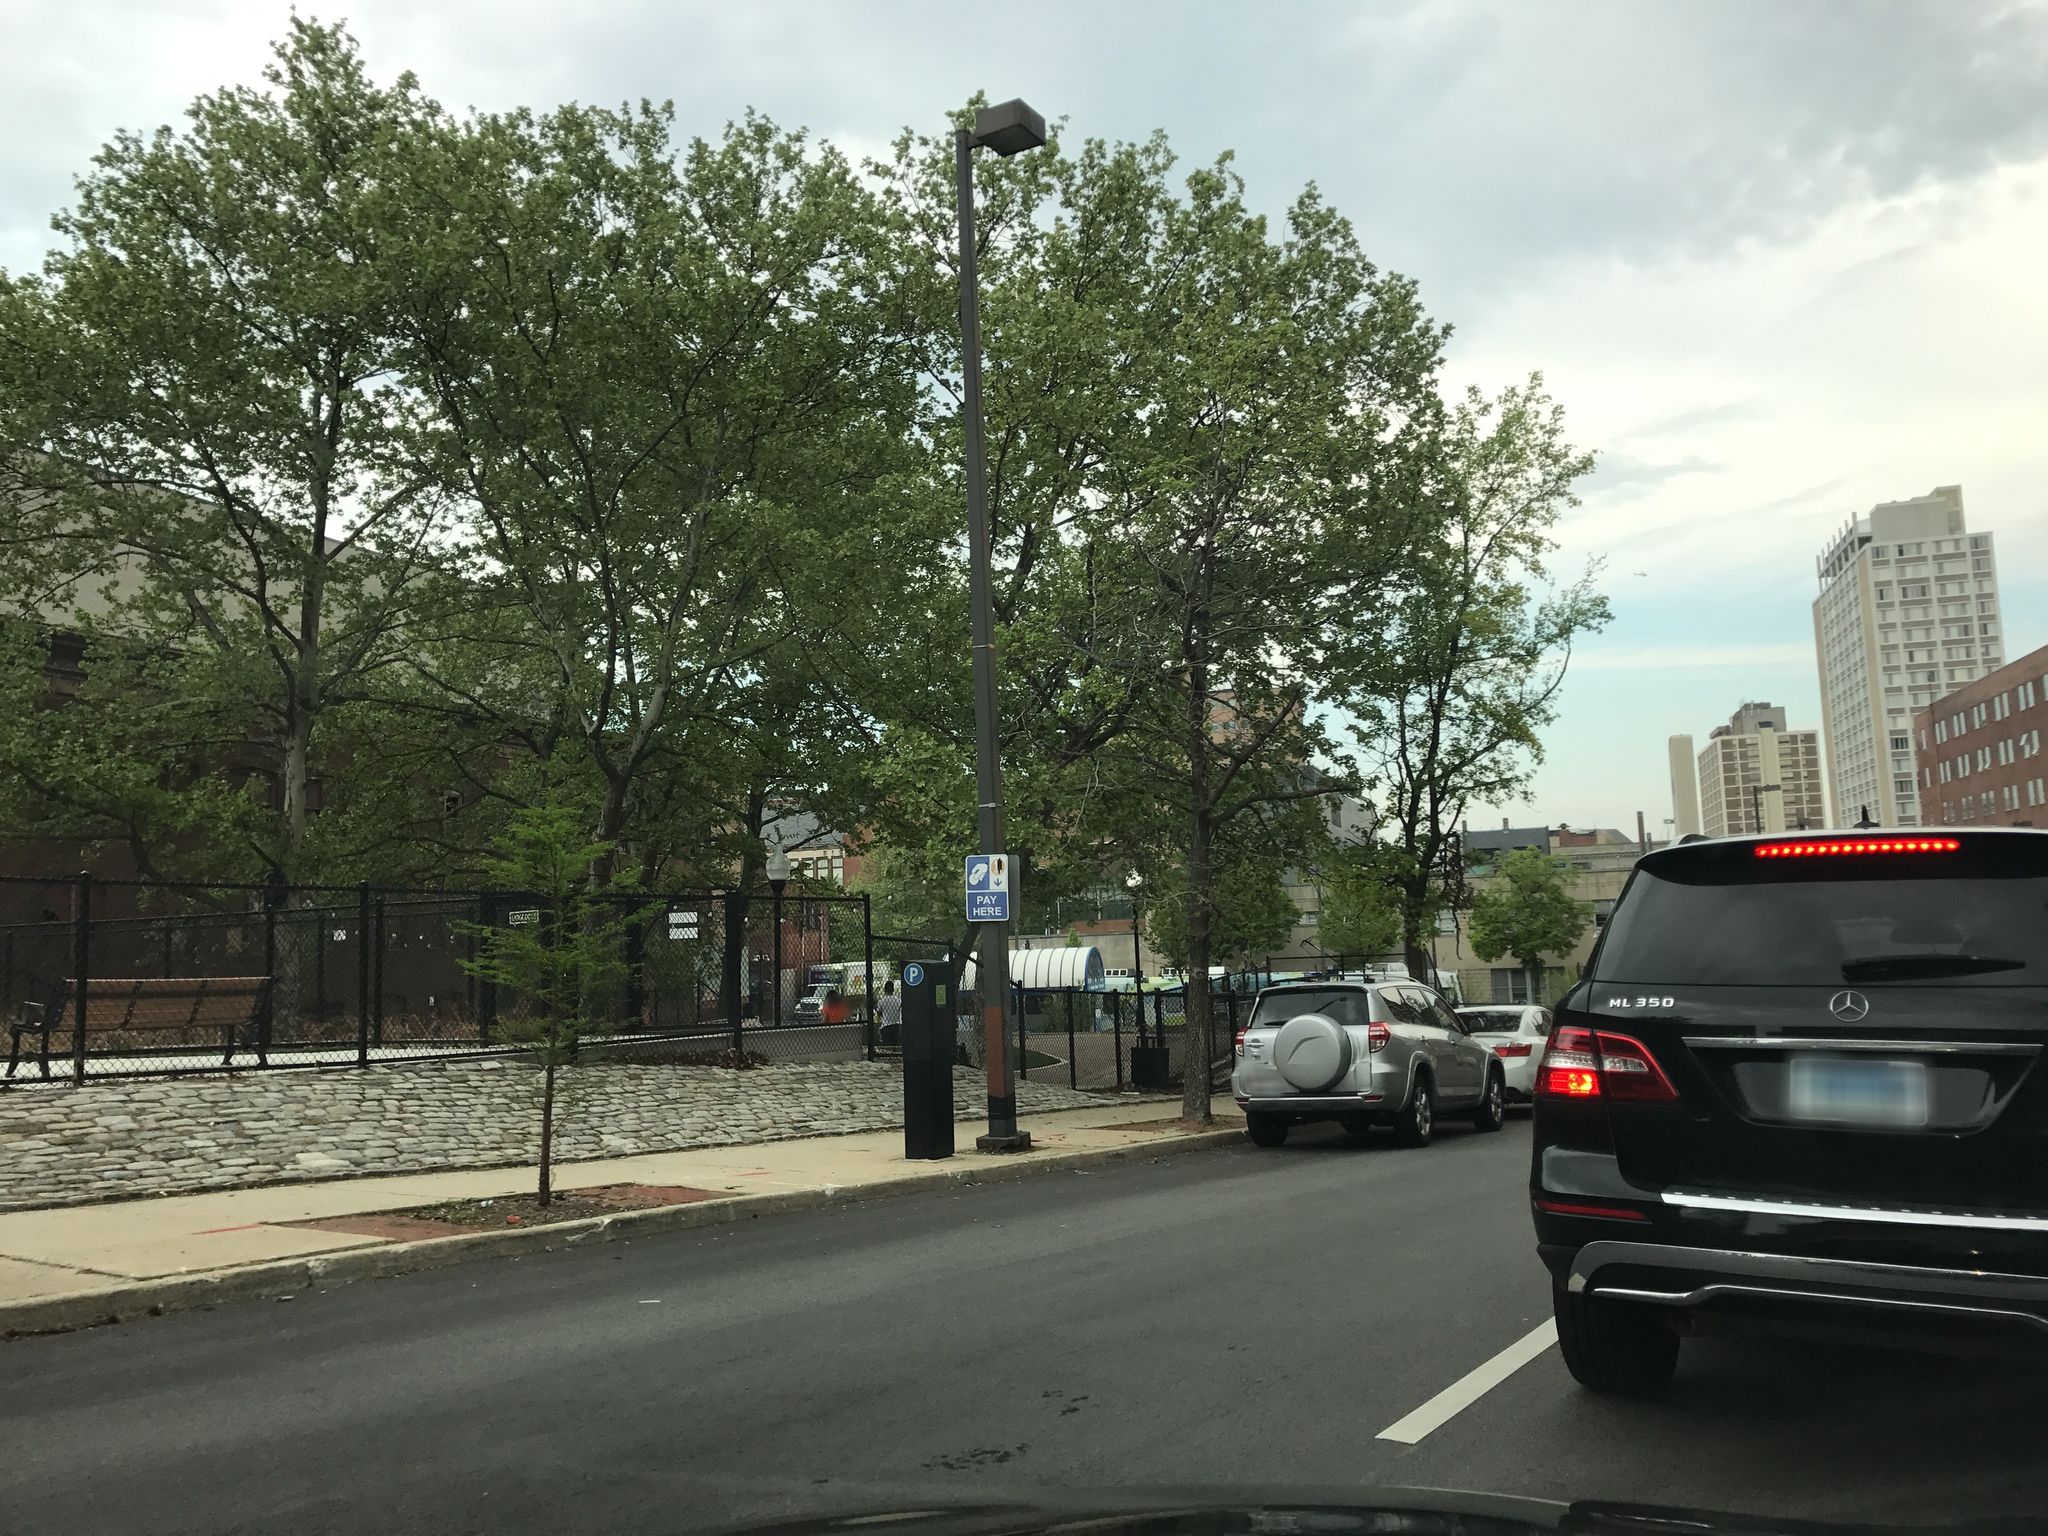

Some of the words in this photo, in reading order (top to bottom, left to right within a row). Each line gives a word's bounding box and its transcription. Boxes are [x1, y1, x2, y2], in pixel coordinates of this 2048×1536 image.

[976, 895, 997, 905] PAY
[973, 906, 1002, 916] HERE
[910, 967, 918, 982] P
[1609, 998, 1631, 1008] ML
[1635, 998, 1675, 1008] 350
